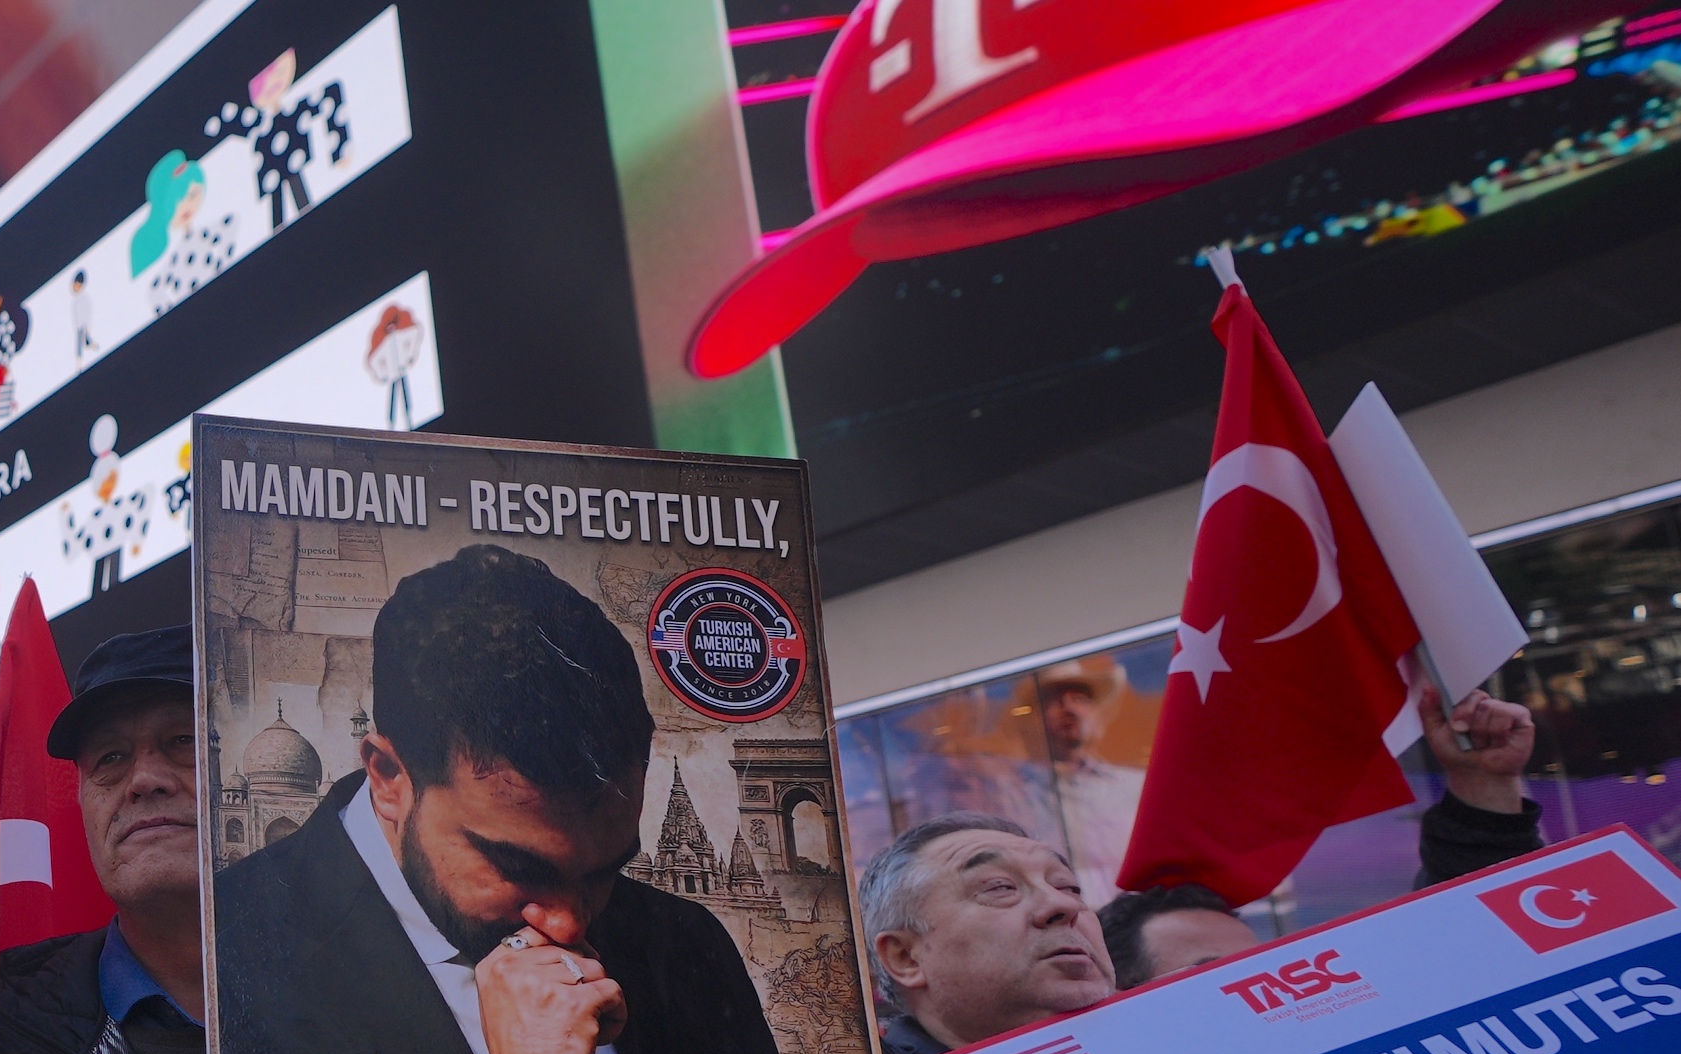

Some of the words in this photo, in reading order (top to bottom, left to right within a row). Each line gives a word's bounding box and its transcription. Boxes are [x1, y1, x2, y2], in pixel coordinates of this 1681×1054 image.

[221, 460, 427, 526] MAMDANI
[470, 480, 789, 558] RESPECTFULLY,
[690, 592, 715, 608] NEW
[726, 592, 758, 613] YORK
[698, 619, 753, 637] TURKISH
[695, 634, 761, 654] AMERICAN
[704, 651, 754, 669] CENTER
[693, 677, 733, 699] SINCE
[743, 679, 771, 699] 2018
[1219, 949, 1363, 1014] TASC
[1264, 1008, 1296, 1024] Turkish
[1295, 995, 1336, 1014] American
[1335, 981, 1374, 1000] National
[1296, 1006, 1335, 1023] Steering
[1332, 990, 1380, 1010] Committee
